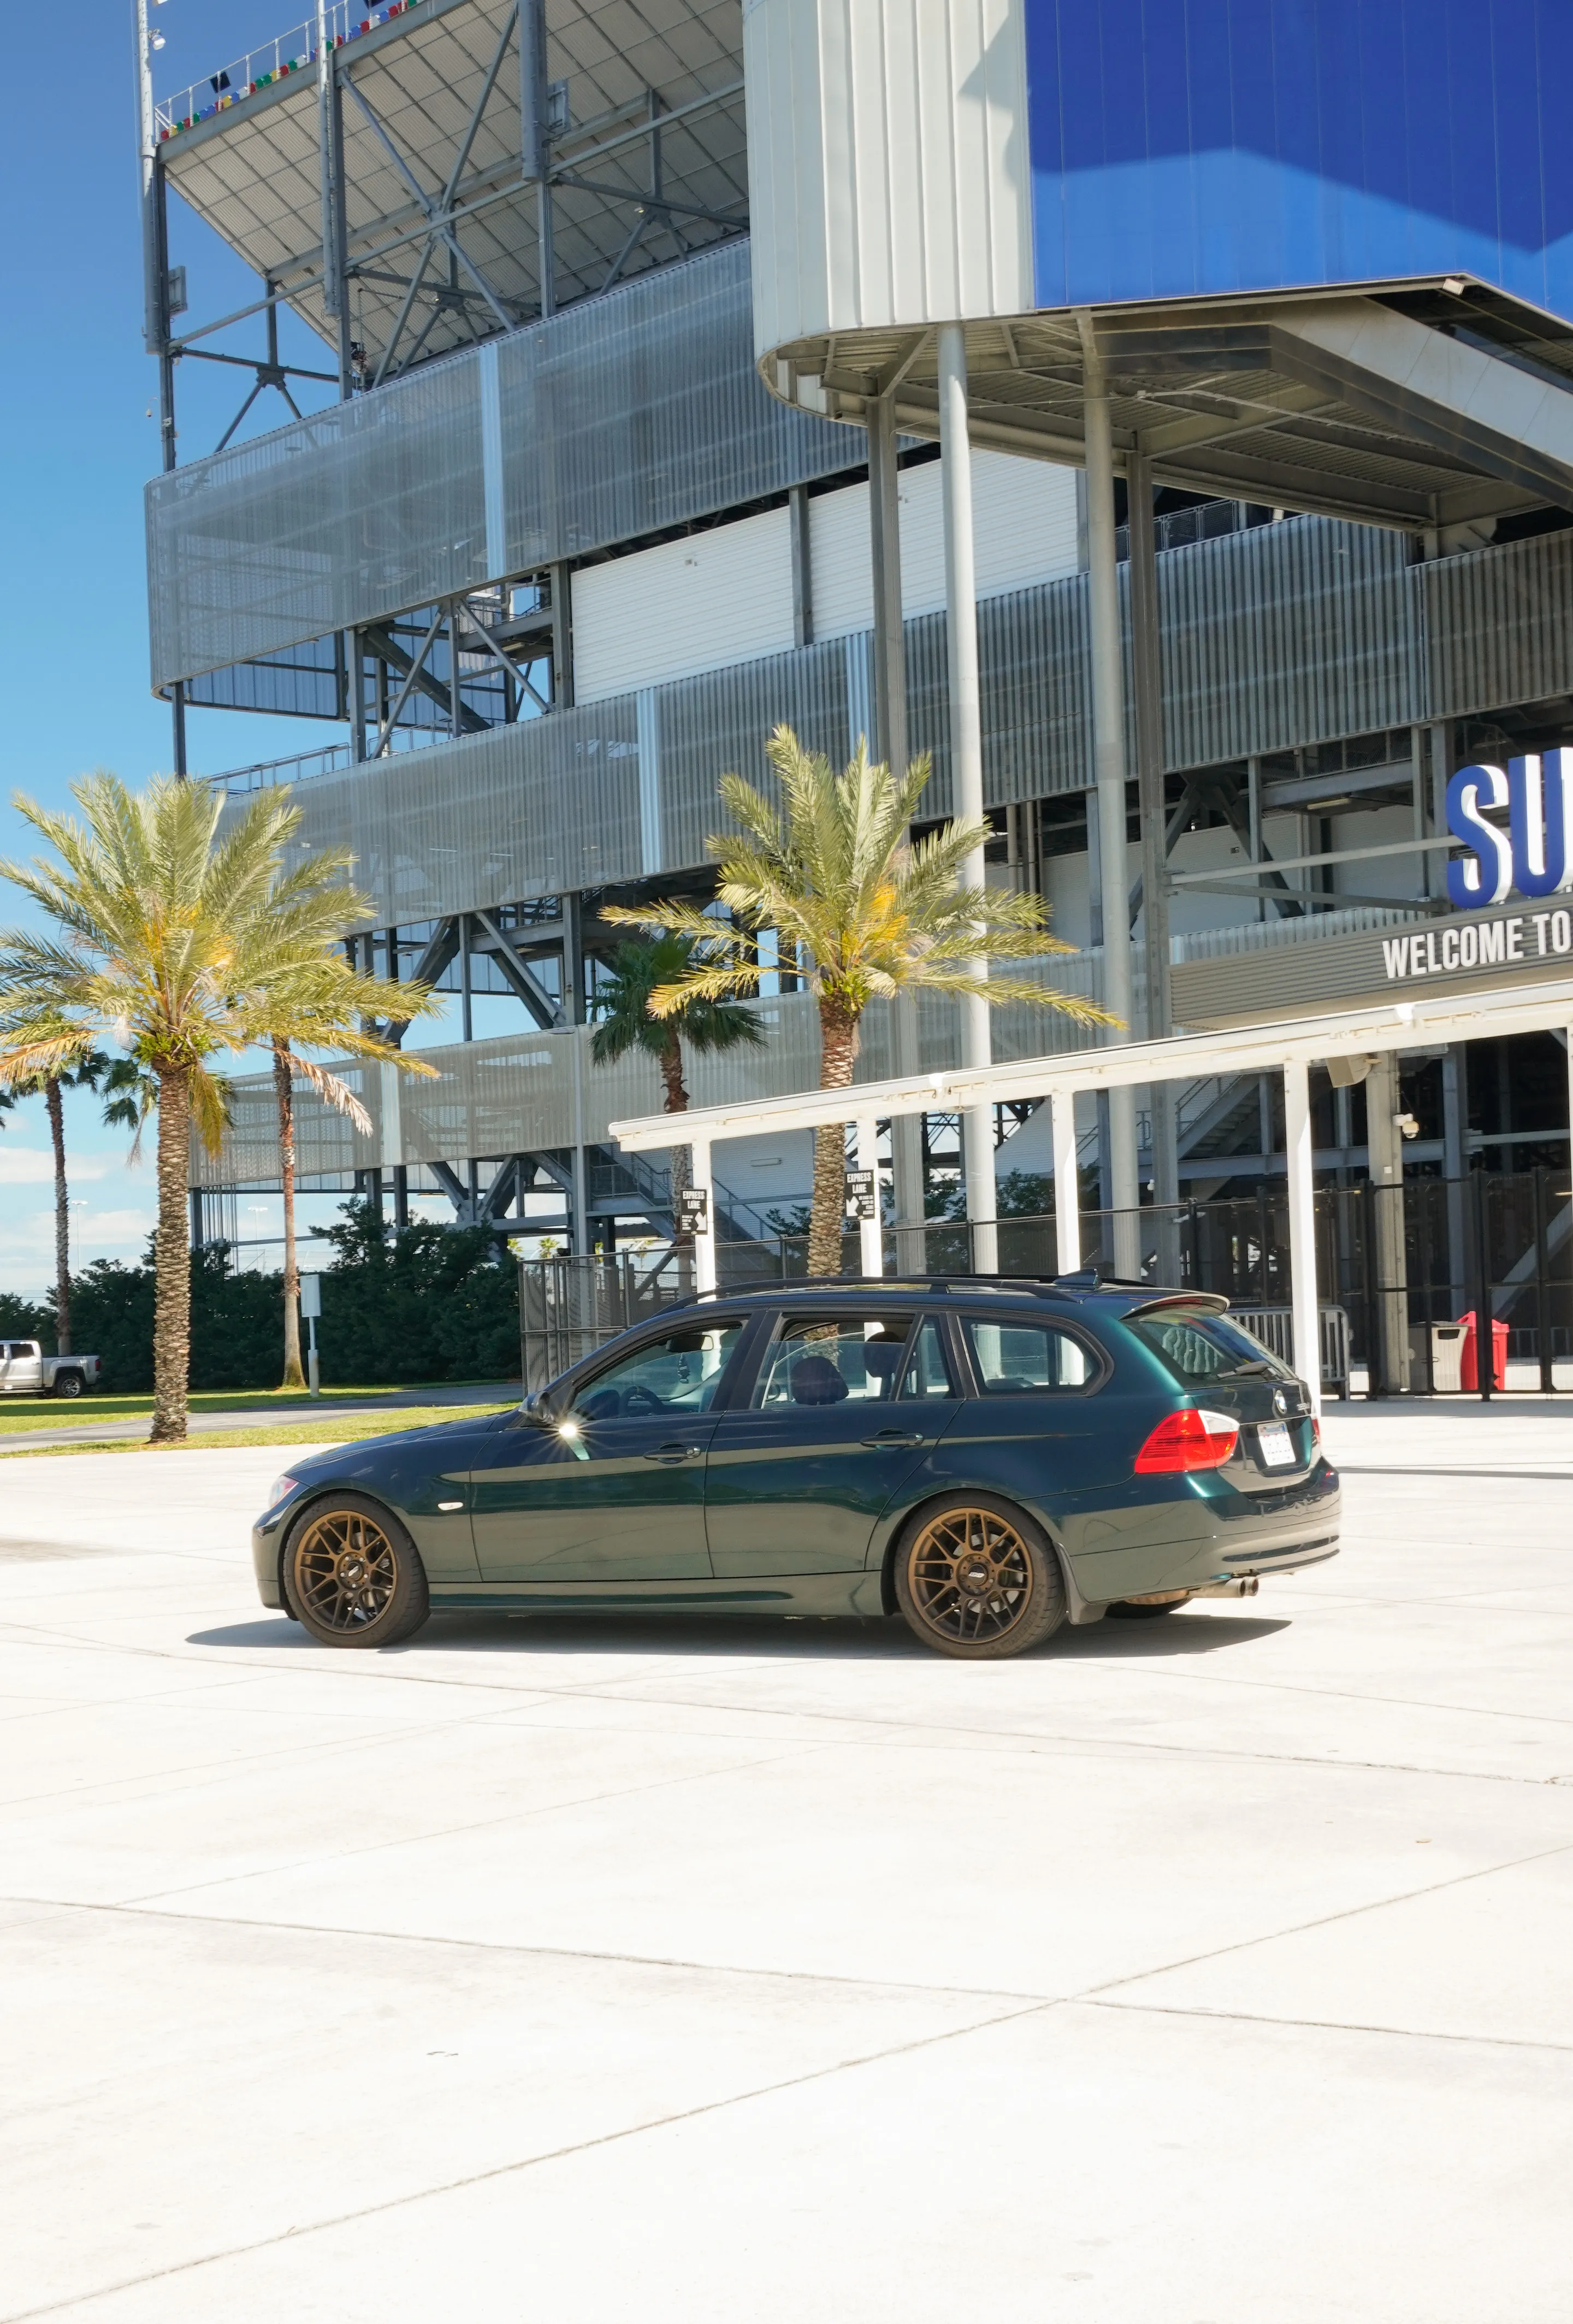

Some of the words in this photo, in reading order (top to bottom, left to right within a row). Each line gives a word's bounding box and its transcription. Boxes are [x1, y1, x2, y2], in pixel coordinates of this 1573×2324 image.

[1382, 918, 1524, 979] WELCOME
[1532, 911, 1571, 955] TO
[847, 1172, 872, 1183] EXPRESS
[853, 1184, 867, 1194] LANE
[683, 1191, 705, 1200] EXPRESS
[688, 1200, 701, 1209] LANE
